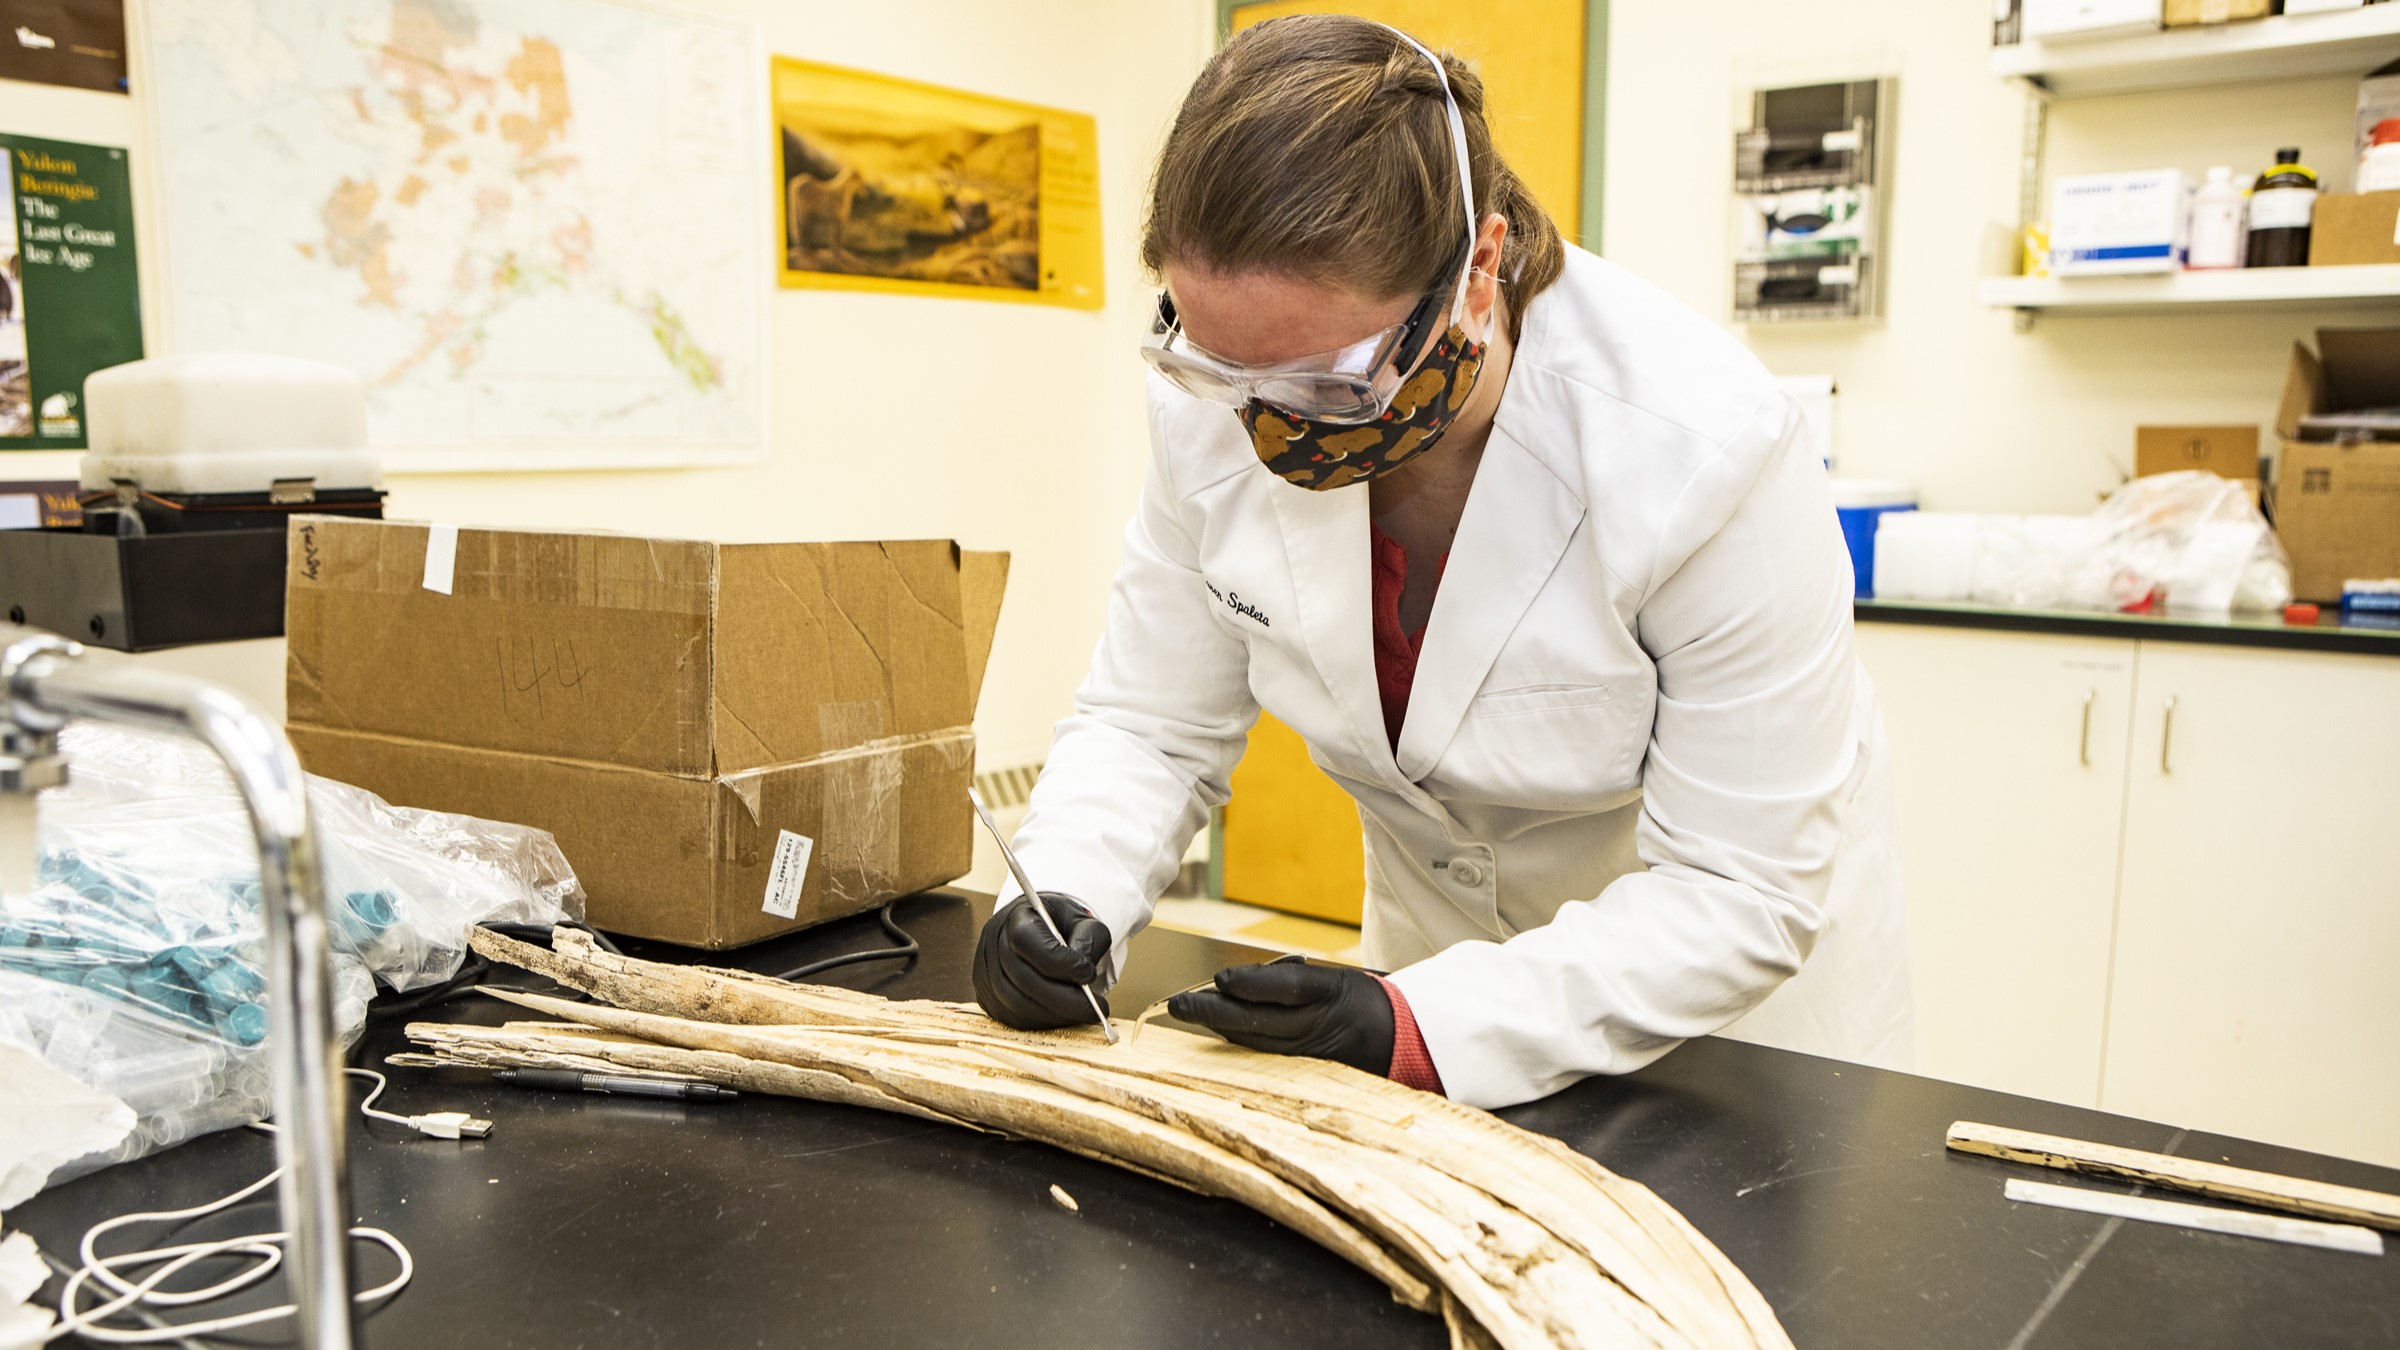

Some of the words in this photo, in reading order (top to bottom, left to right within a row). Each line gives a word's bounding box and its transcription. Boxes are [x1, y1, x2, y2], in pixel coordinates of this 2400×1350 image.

[18, 149, 77, 174] Yukon
[19, 195, 60, 219] The
[23, 219, 62, 241] Last
[63, 222, 116, 247] Great
[25, 242, 54, 264] Ice
[56, 245, 94, 272] Age
[1227, 591, 1270, 627] Spaleta
[496, 635, 591, 722] 144
